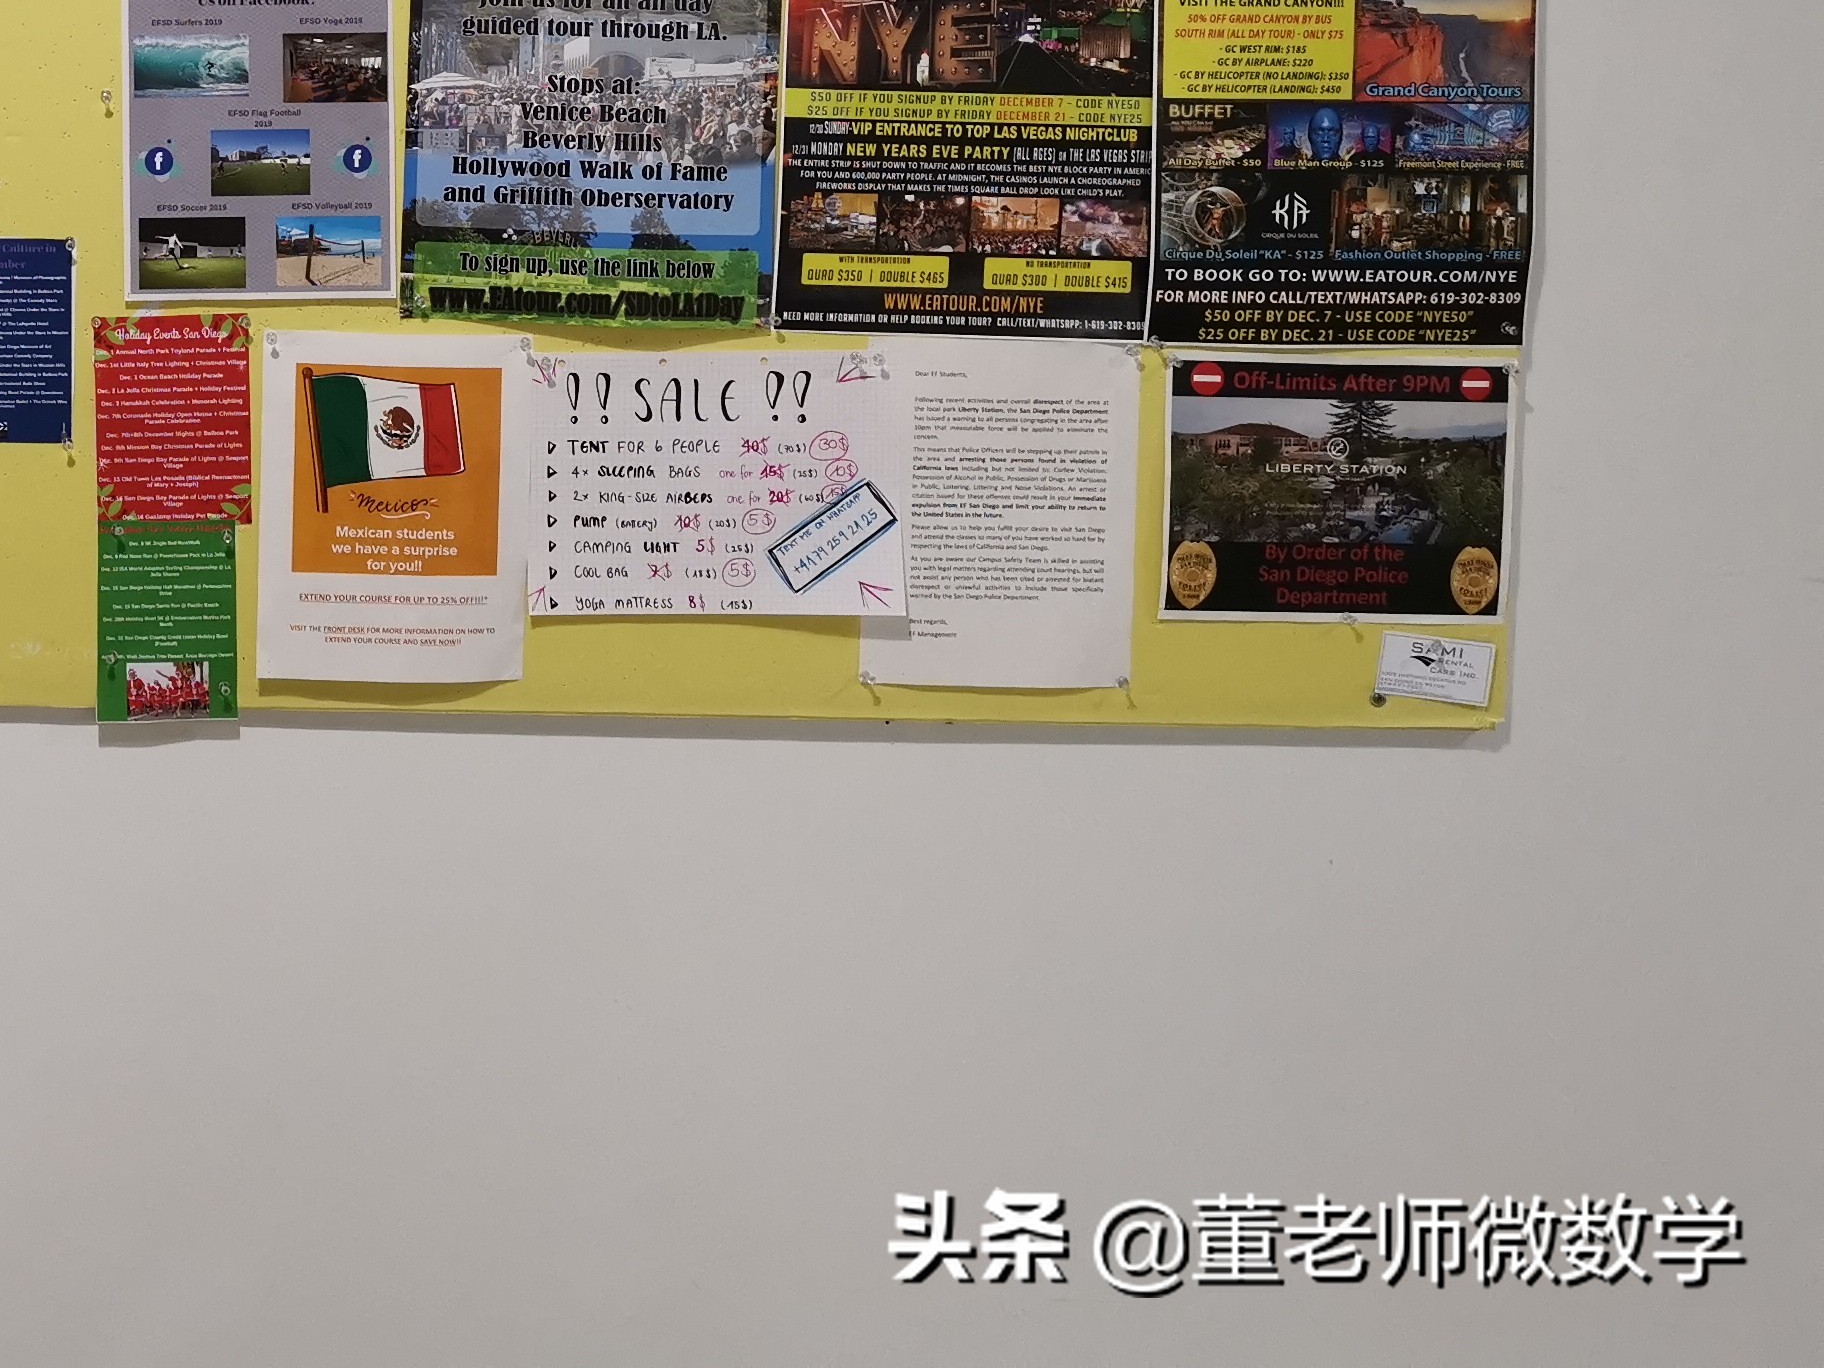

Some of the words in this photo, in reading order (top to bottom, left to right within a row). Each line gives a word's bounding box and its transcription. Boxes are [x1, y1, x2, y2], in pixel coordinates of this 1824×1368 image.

[520, 102, 591, 124] Venice
[598, 103, 667, 125] Beach
[1168, 104, 1234, 120] BUFFET
[522, 130, 607, 153] Beverly
[616, 130, 664, 154] Hills
[1311, 269, 1518, 285] WWW.EATOUR.COM/NYE
[884, 293, 1044, 315] WWW.EATOUR.COM/NYE
[1233, 372, 1337, 392] Off-Limits
[1344, 374, 1397, 392] After
[1402, 375, 1450, 393] 9PM
[634, 378, 740, 423] SALE
[1266, 464, 1334, 473] LIBERTY
[1339, 464, 1407, 474] STATION
[335, 526, 392, 540] Mexican
[396, 527, 455, 541] students
[331, 544, 351, 554] we
[355, 542, 387, 556] have
[391, 546, 400, 556] a
[403, 543, 458, 560] surprise
[366, 558, 386, 571] for
[390, 558, 422, 574] you!!
